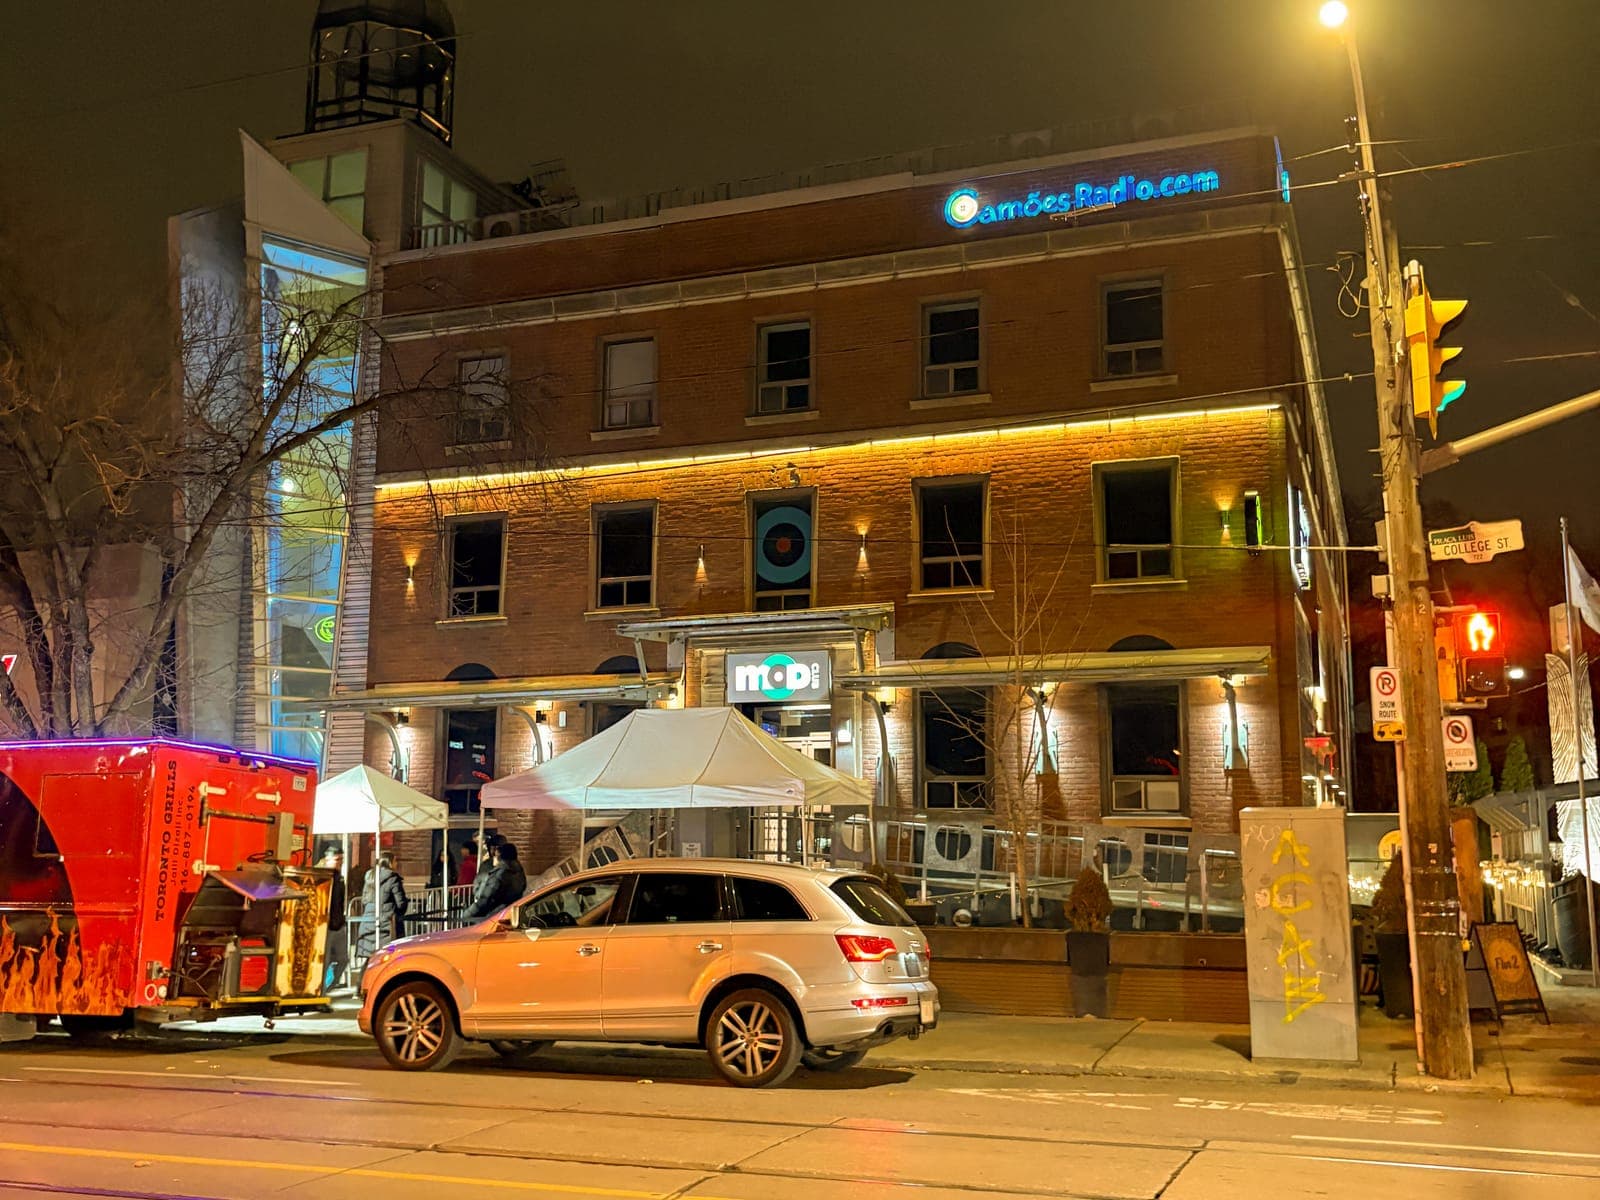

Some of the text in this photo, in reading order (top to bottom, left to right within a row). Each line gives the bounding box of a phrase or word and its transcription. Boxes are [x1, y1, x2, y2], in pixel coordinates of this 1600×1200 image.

[1443, 537, 1512, 556] COLLEGE ST.
[1379, 700, 1396, 709] SNOW
[1378, 710, 1397, 719] ROUTE
[155, 760, 177, 922] TORONTO GRILLS
